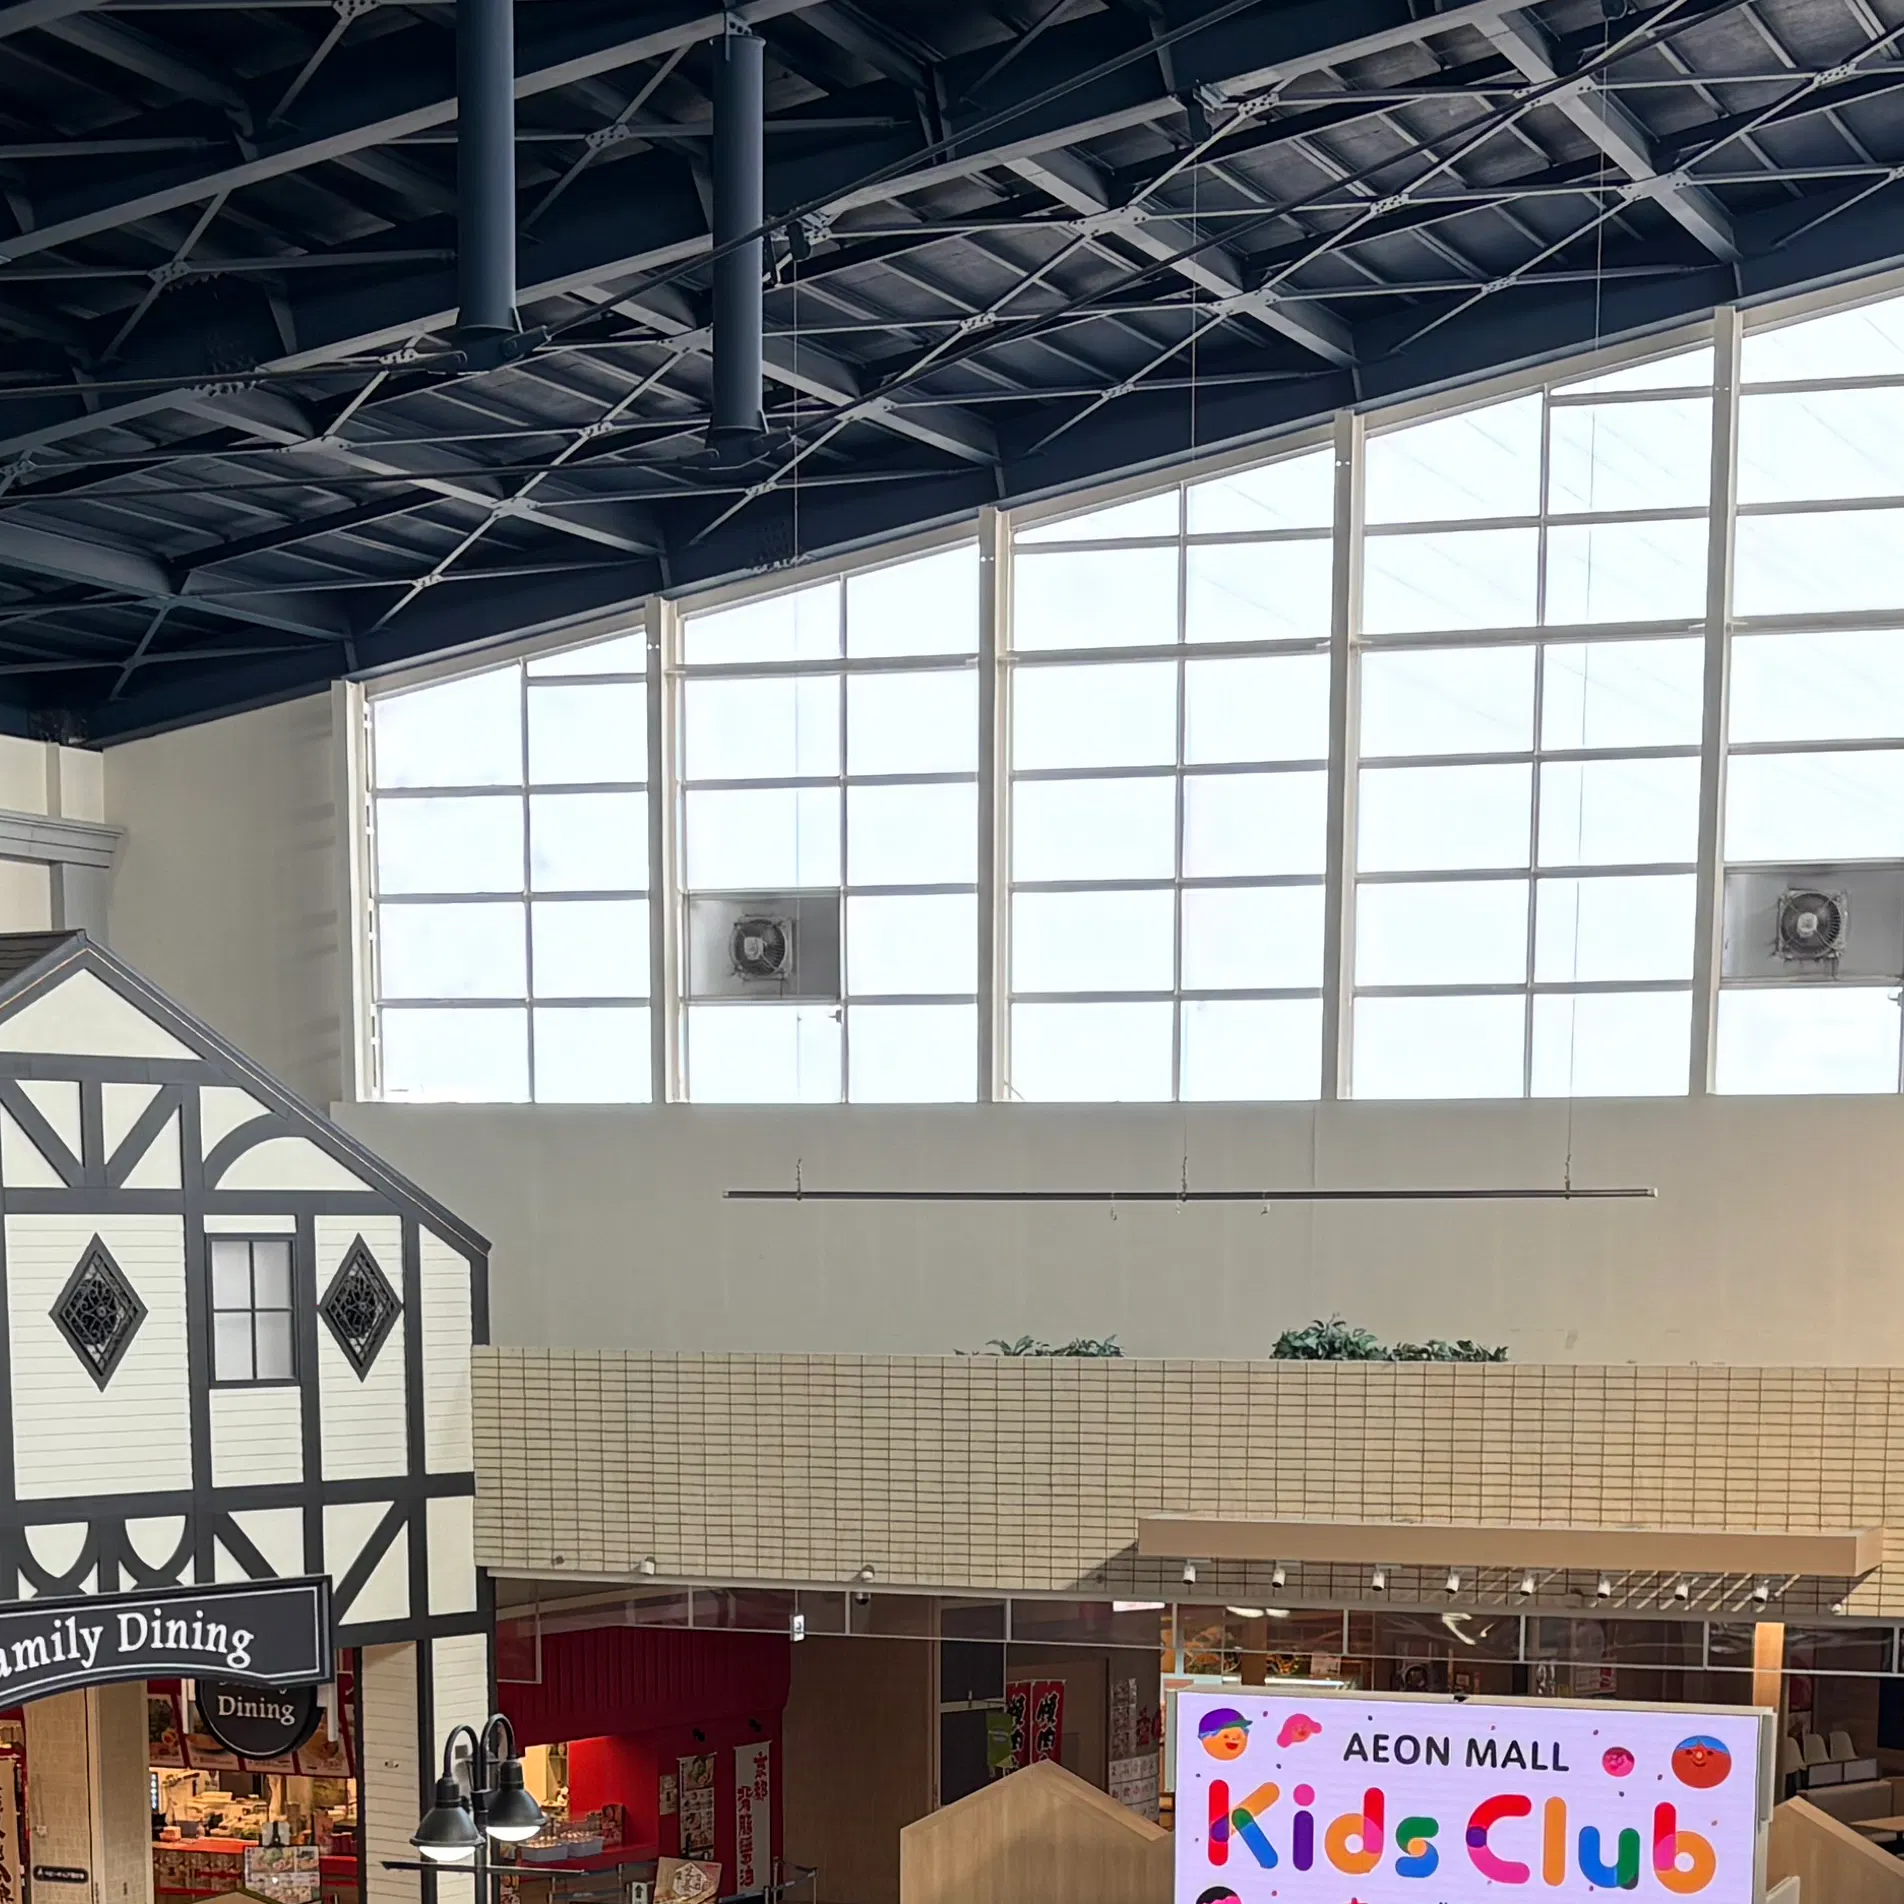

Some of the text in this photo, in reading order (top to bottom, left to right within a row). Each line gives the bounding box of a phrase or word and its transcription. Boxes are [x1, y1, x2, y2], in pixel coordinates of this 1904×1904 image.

[117, 1608, 254, 1669] Dining
[217, 1695, 296, 1725] Dining
[1343, 1732, 1570, 1773] AEON MALL
[1207, 1778, 1718, 1895] Kids Club
